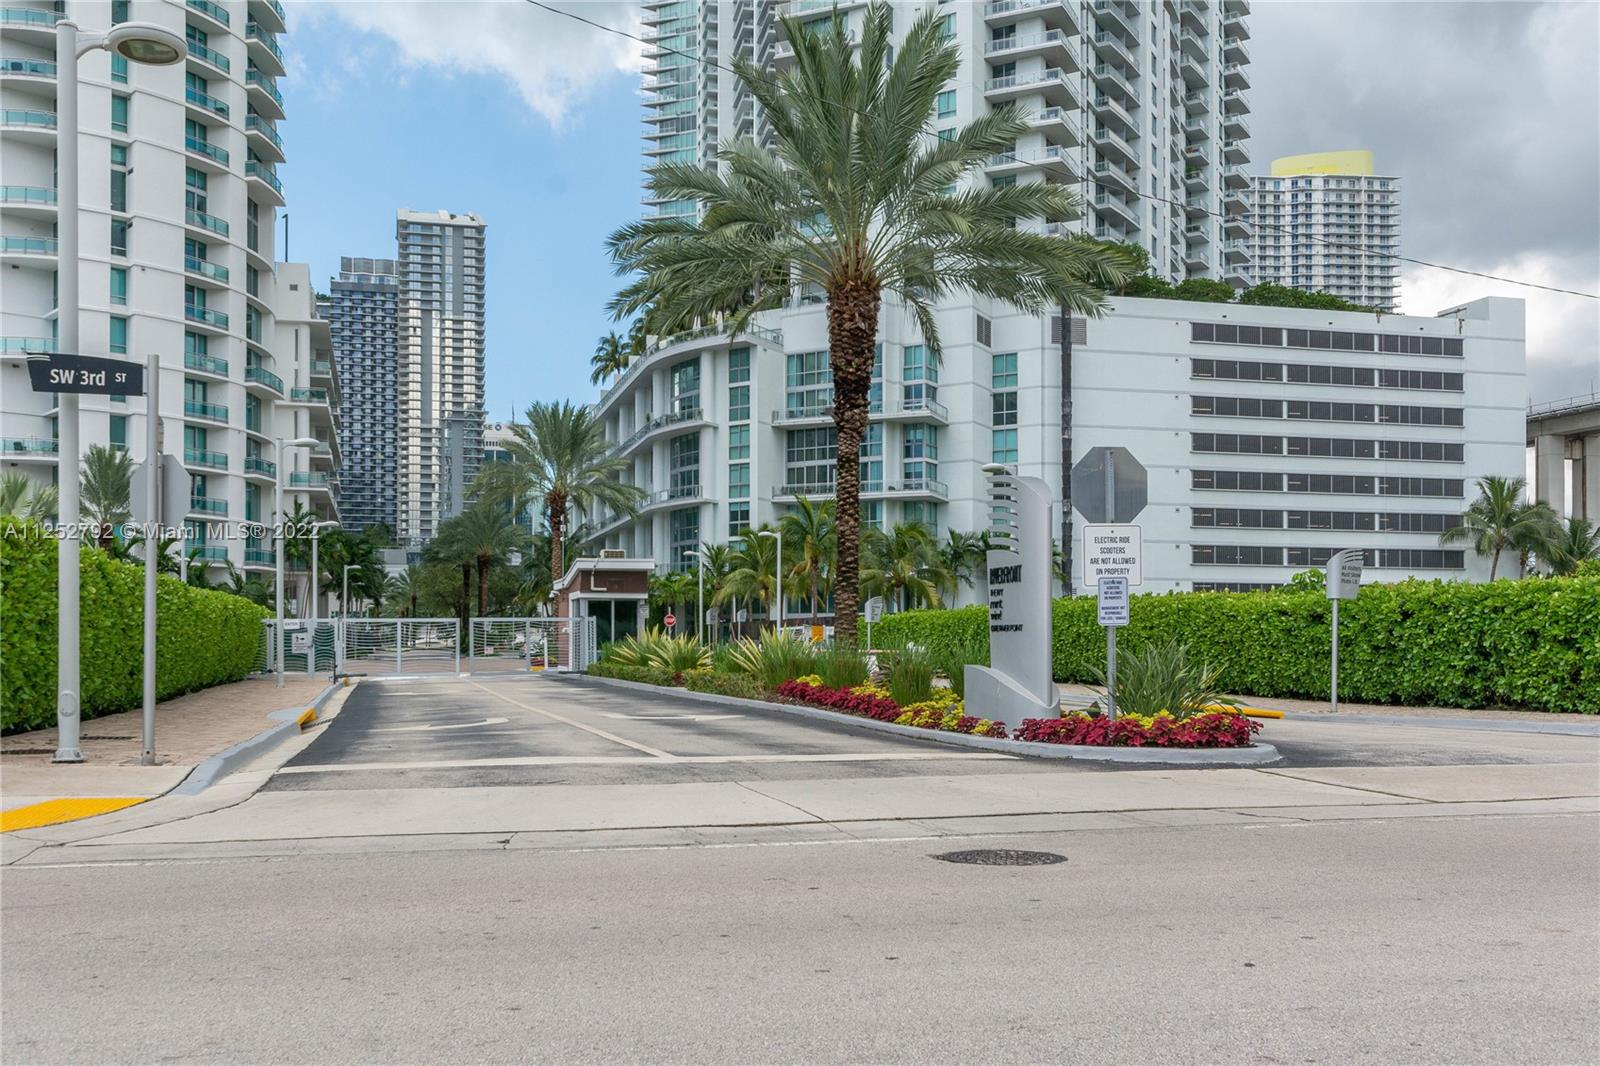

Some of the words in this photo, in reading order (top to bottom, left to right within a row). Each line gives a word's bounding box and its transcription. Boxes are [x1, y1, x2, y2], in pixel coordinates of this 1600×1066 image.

[50, 369, 75, 385] SW
[80, 370, 106, 386] 3rd
[115, 372, 127, 383] ST
[1094, 536, 1118, 544] ELECTRIC
[1119, 536, 1131, 544] RIDE
[1099, 546, 1126, 554] SCOOTERS
[1090, 557, 1099, 565] ARE
[1101, 557, 1111, 565] NOT
[1112, 557, 1136, 565] ALLOWED
